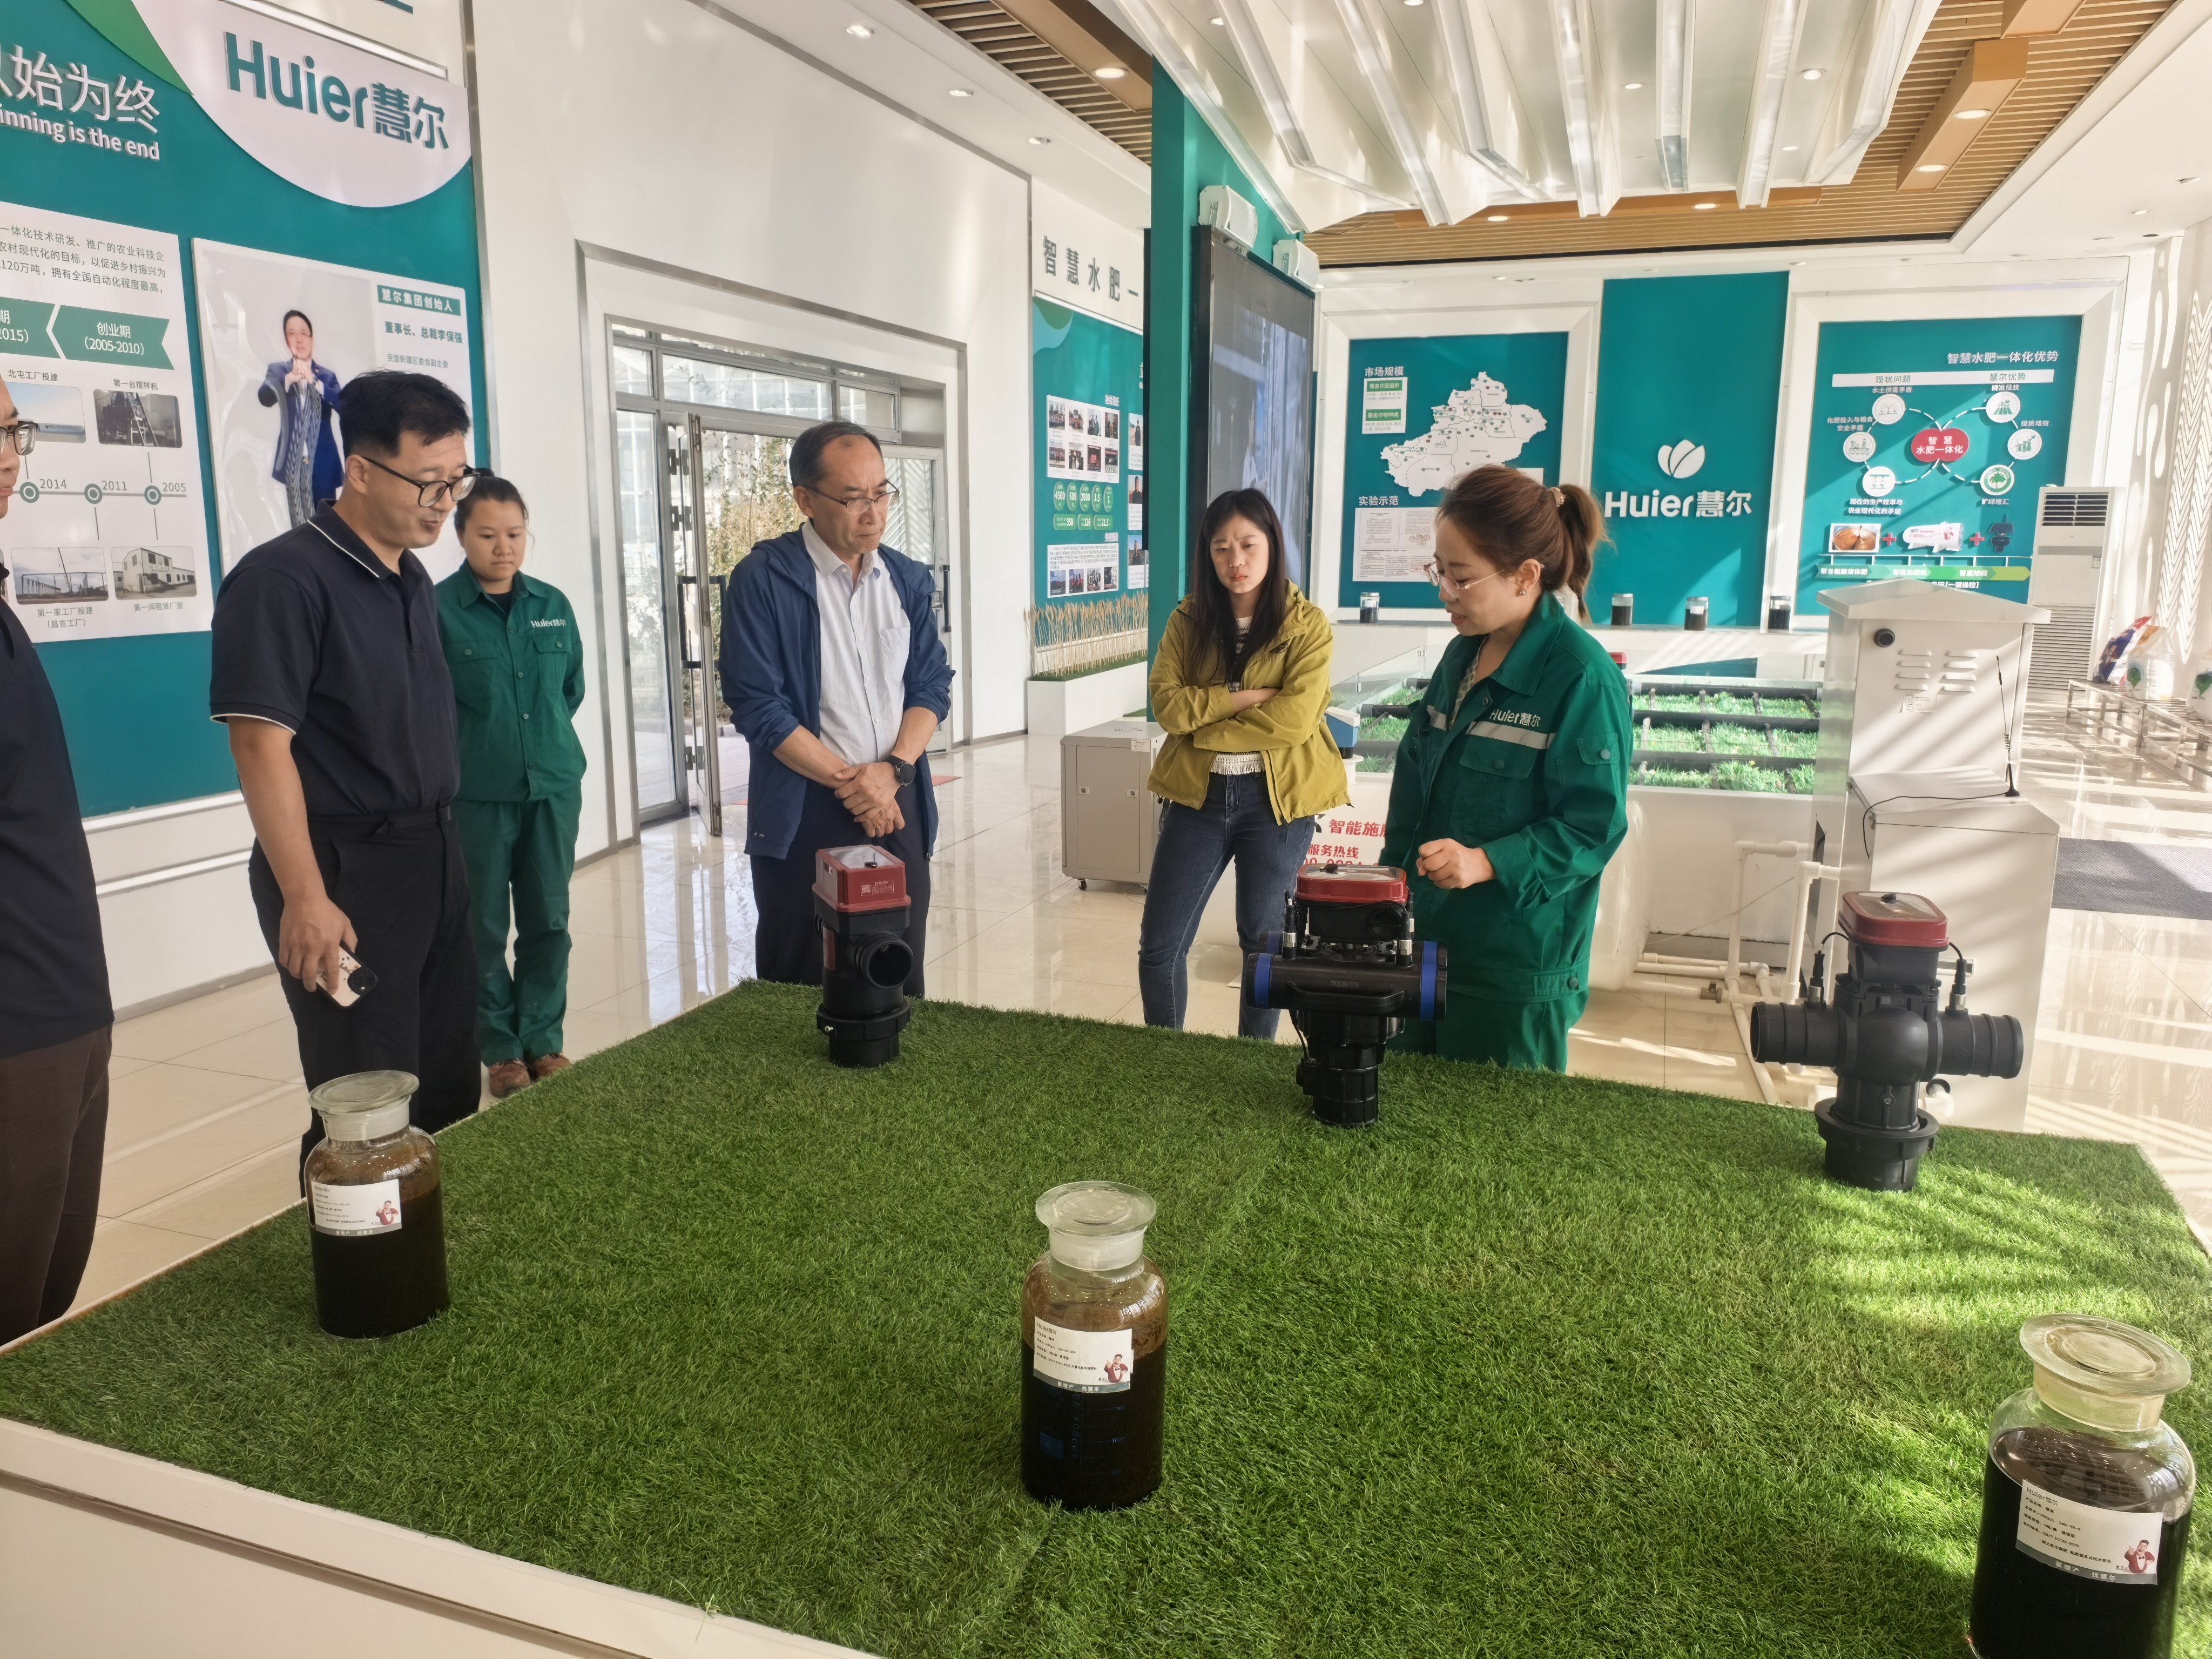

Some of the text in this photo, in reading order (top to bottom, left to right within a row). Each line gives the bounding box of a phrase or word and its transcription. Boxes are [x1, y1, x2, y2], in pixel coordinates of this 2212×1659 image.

[224, 31, 449, 150] Huier慧尔
[68, 120, 86, 143] is
[87, 127, 122, 151] the
[125, 141, 160, 160] end
[1042, 234, 1139, 302] 智慧水肥一
[0, 260, 163, 294] 120万吨，拥有全国自动化程度最高，
[381, 288, 453, 312] 慧尔集团创始人
[0, 328, 29, 343] 015)
[96, 321, 131, 338] 创业期
[385, 321, 463, 343] 董事长、总裁李保强
[1947, 350, 2059, 365] 智慧水肥一体化优势
[8, 369, 58, 382] 北屯工厂投建
[1365, 366, 1404, 377] 市场规模
[1875, 373, 2026, 383] 现状问题 慧尔优势
[113, 379, 158, 390] 第一台搅拌机
[1916, 445, 1964, 454] 水肥一体化
[39, 478, 67, 490] 2014
[102, 480, 127, 491] 2011
[163, 483, 186, 493] 2005
[1358, 495, 1399, 506] 实验示范
[1604, 489, 1752, 517] Huier慧尔
[37, 607, 93, 617] 第一家工厂投建
[133, 602, 183, 612] 第一间租赁厂房
[1307, 844, 1359, 859] 服务热线
